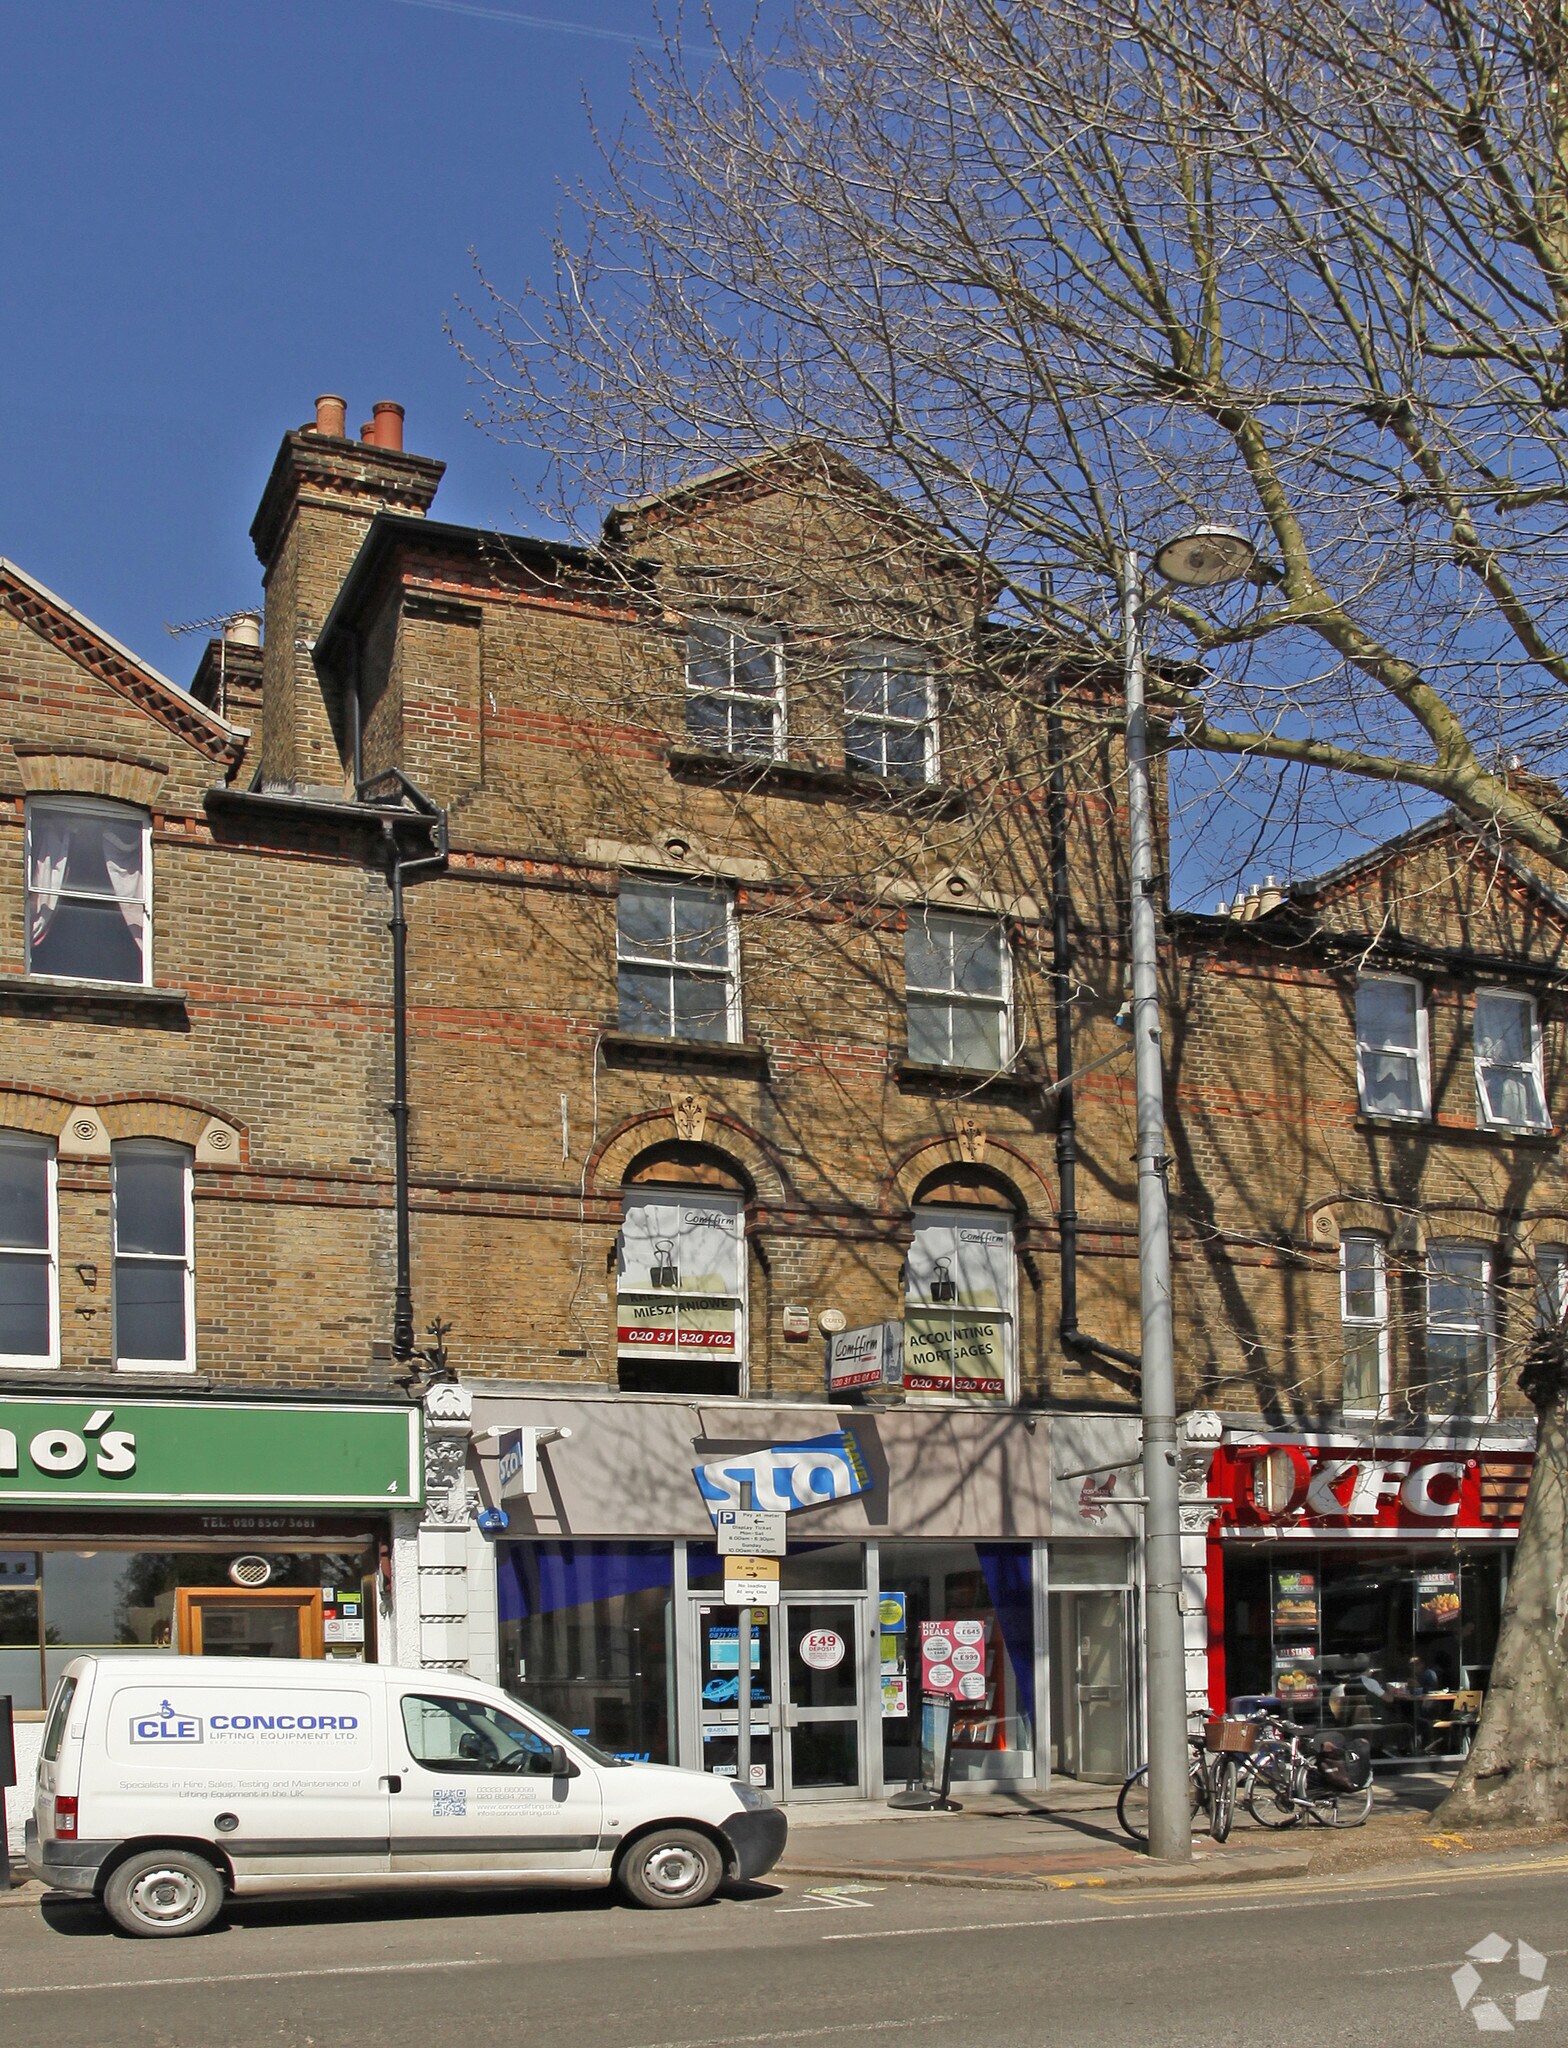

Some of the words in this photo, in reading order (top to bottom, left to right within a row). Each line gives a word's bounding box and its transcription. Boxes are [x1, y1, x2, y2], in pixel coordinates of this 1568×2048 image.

[628, 1331, 654, 1341] 020
[657, 1332, 673, 1342] 31
[679, 1333, 704, 1343] 320
[708, 1334, 732, 1345] 102
[910, 1325, 994, 1347] ACCOUNTING
[913, 1343, 994, 1365] MORTGAGES
[911, 1378, 933, 1388] 020
[935, 1379, 949, 1388] 31
[955, 1380, 977, 1390] 320
[981, 1380, 1001, 1391] 102
[840, 1431, 870, 1489] TRAVEL
[387, 1480, 398, 1493] 4
[704, 1449, 852, 1514] sta
[1293, 1459, 1466, 1517] KFC
[201, 1517, 231, 1527] TEL:
[233, 1518, 255, 1527] 020
[722, 1512, 734, 1523] P
[809, 1635, 836, 1647] £49
[210, 1715, 358, 1730] CONCORD
[138, 1721, 195, 1738] CLE
[210, 1732, 255, 1740] LIFTING
[261, 1732, 330, 1740] EQUIPMENT
[335, 1732, 358, 1740] LTD.
[119, 1781, 169, 1790] Specialists
[183, 1780, 206, 1789] Hire,
[208, 1780, 236, 1789] Sales,
[238, 1779, 269, 1789] Testing
[272, 1780, 289, 1788] and
[292, 1779, 349, 1788] Maintenance
[352, 1779, 361, 1787] of
[179, 1791, 208, 1799] Lifting
[211, 1791, 258, 1799] Equipment
[272, 1790, 287, 1798] the
[290, 1790, 304, 1798] UK
